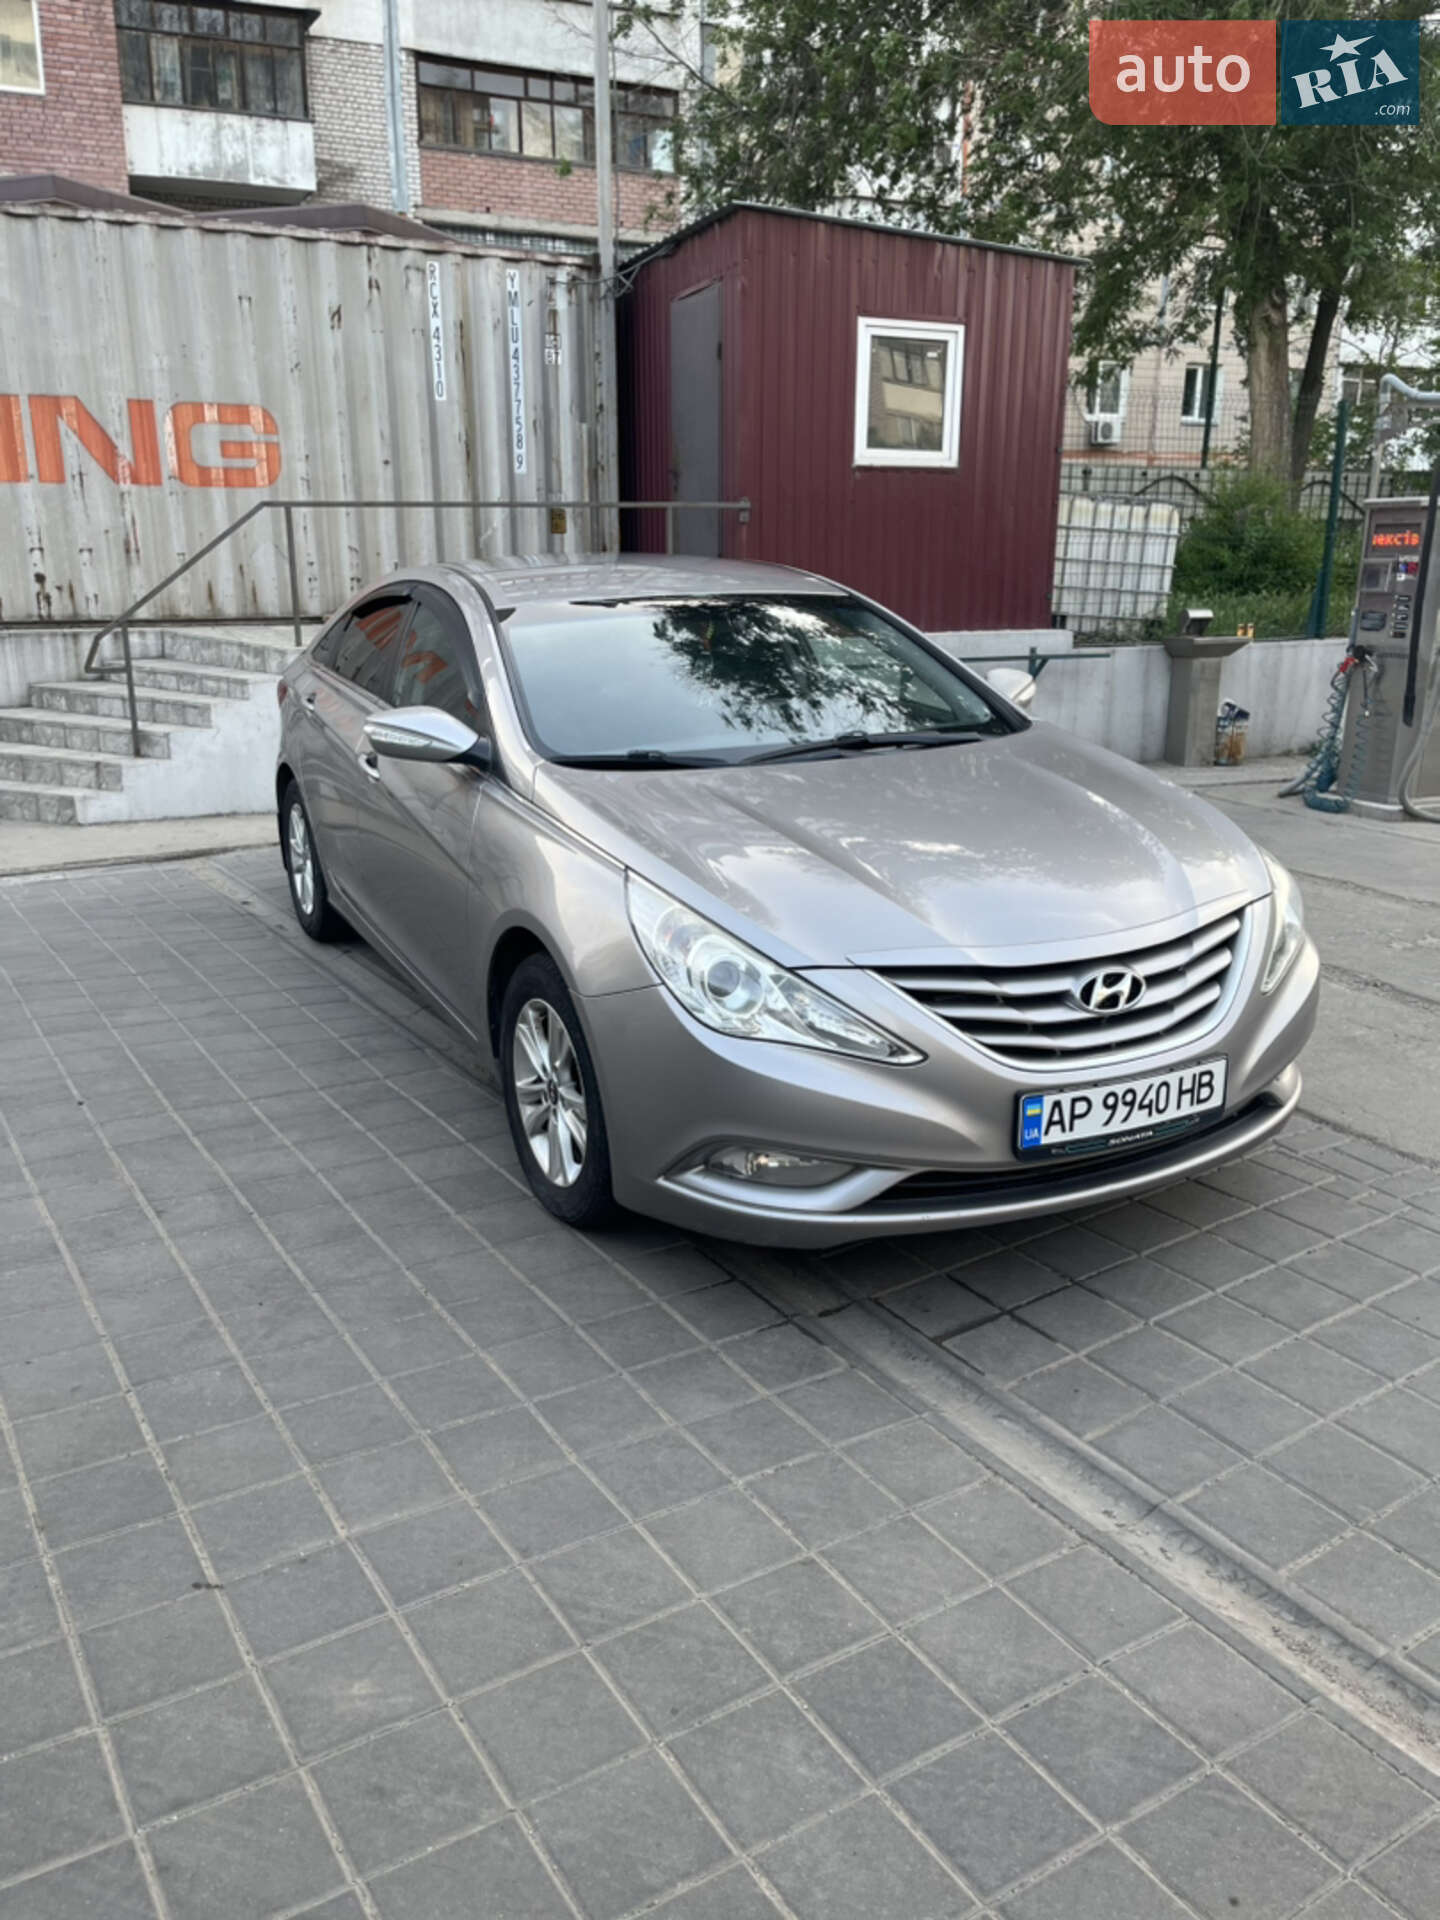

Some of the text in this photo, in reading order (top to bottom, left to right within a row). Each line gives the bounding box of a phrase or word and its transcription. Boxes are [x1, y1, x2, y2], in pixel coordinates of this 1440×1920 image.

[432, 326, 445, 398] 4310
[1024, 1129, 1040, 1140] UA
[1044, 1070, 1215, 1136] AP 9940 HB
